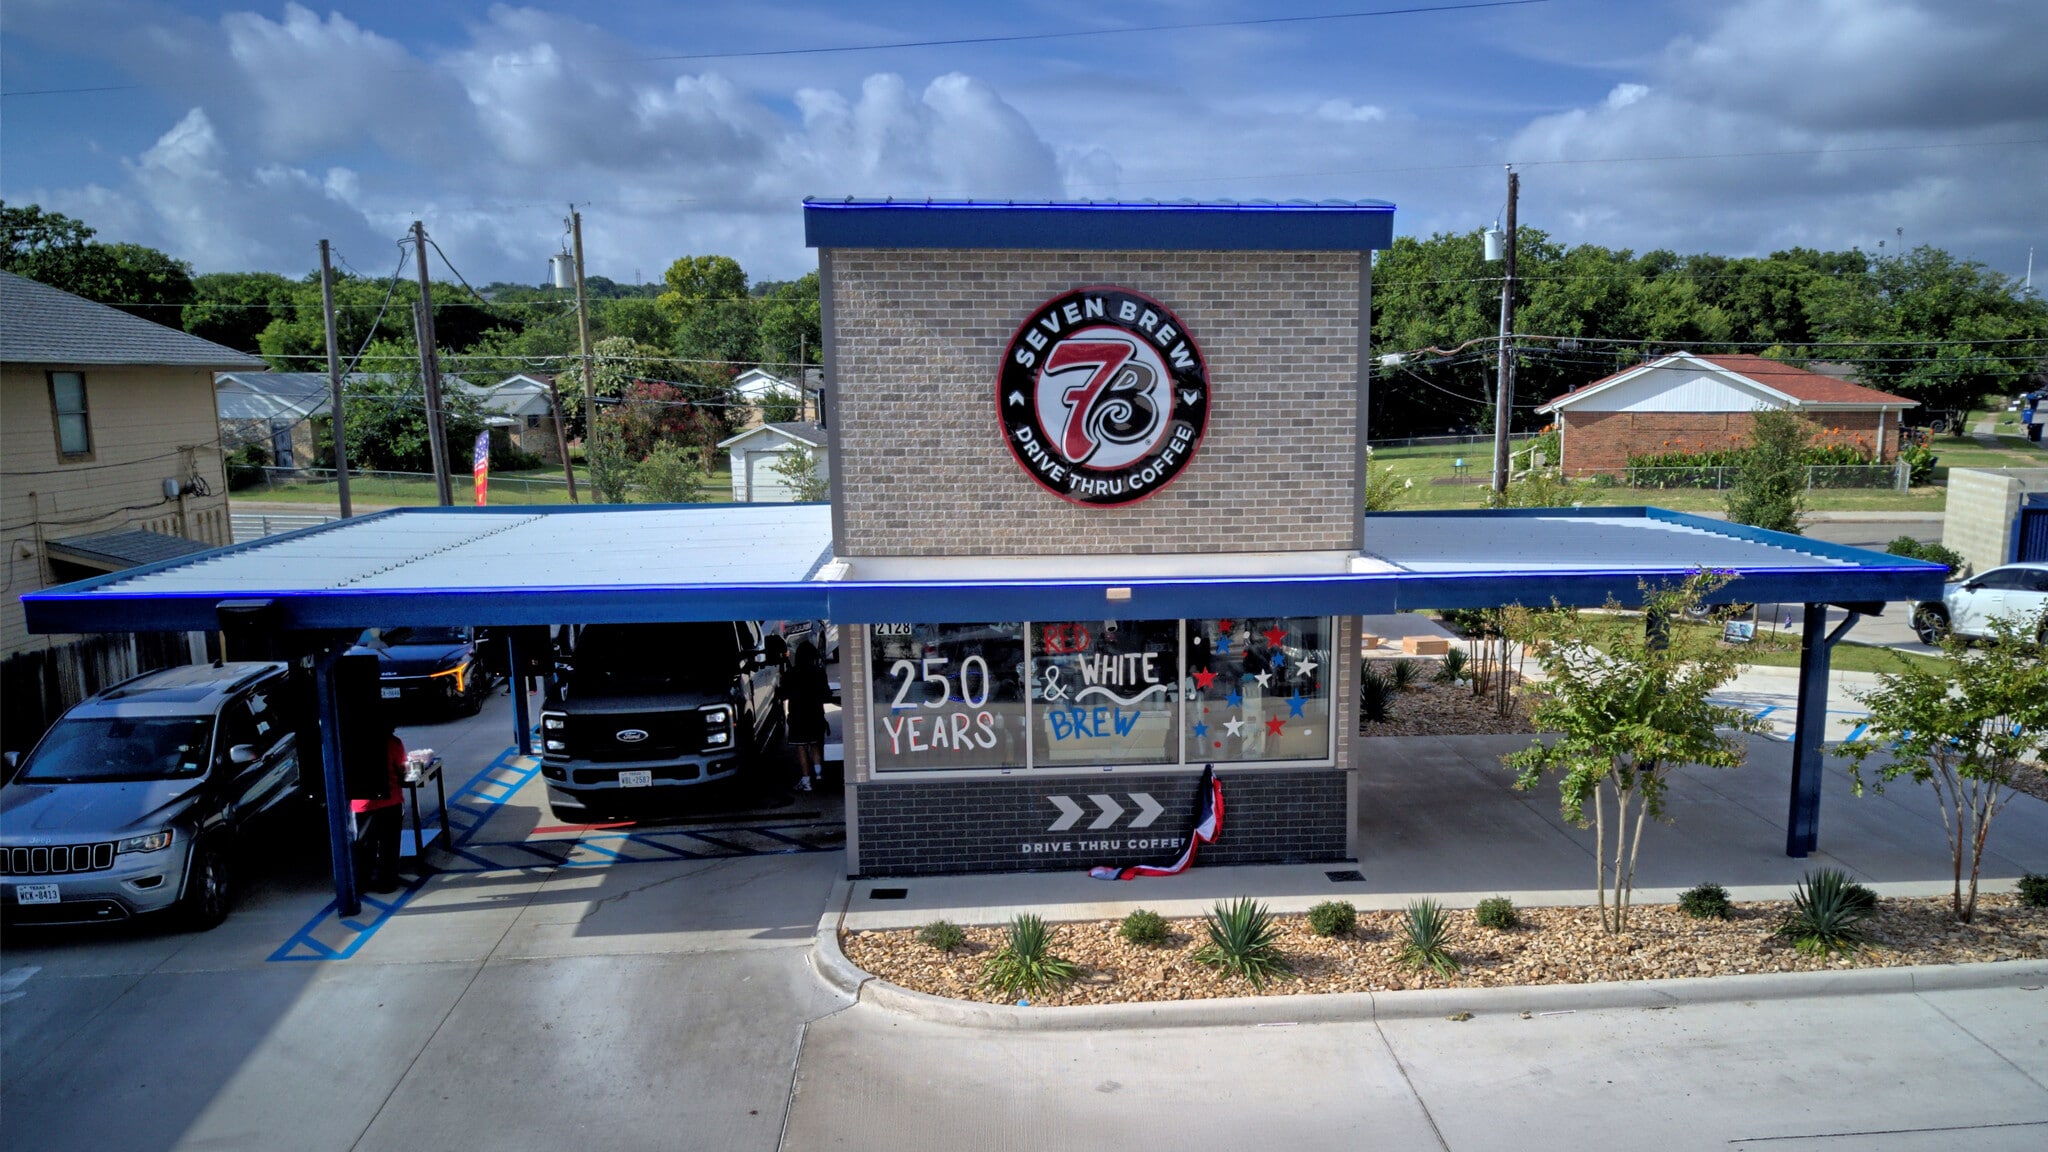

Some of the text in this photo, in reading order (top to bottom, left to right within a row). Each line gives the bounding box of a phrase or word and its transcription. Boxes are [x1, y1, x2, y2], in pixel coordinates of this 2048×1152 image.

[1016, 298, 1195, 370] SEVEN BREW
[1016, 425, 1192, 495] DRIVE THRU COFFEE
[876, 623, 911, 634] 2128
[1043, 623, 1091, 655] RED
[889, 655, 990, 709] 250
[1042, 652, 1160, 701] & WHITE
[622, 732, 641, 740] Ford
[882, 711, 998, 755] YEARS
[1049, 706, 1141, 741] BREW
[29, 836, 52, 845] Jeep
[1022, 842, 1072, 853] DRIVE
[1078, 840, 1121, 851] THRU
